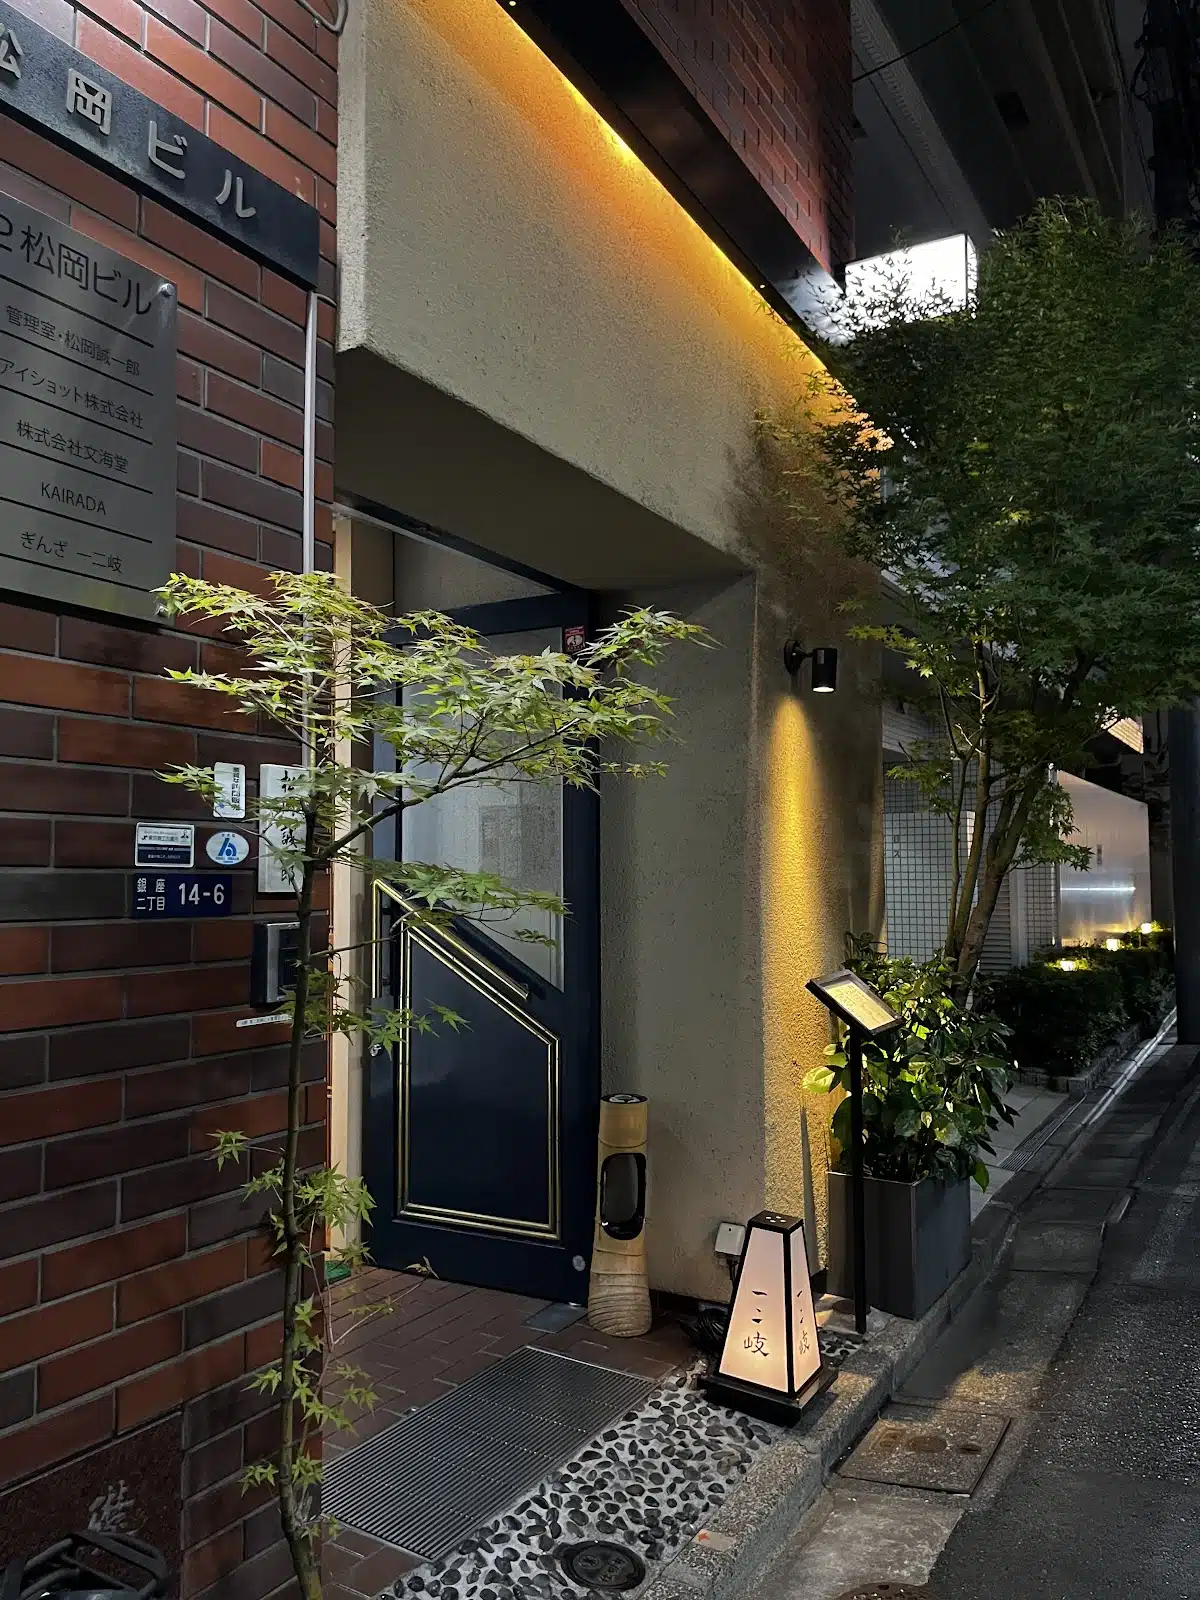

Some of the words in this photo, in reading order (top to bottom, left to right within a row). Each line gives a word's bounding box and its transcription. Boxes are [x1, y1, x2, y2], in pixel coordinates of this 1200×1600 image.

[17, 419, 129, 474] 株式会社文海堂
[41, 481, 107, 516] KAIRADA
[20, 531, 69, 558] ぎんざ
[136, 877, 166, 893] 銀座
[178, 882, 225, 905] 14-6
[136, 896, 166, 911] 二丁目
